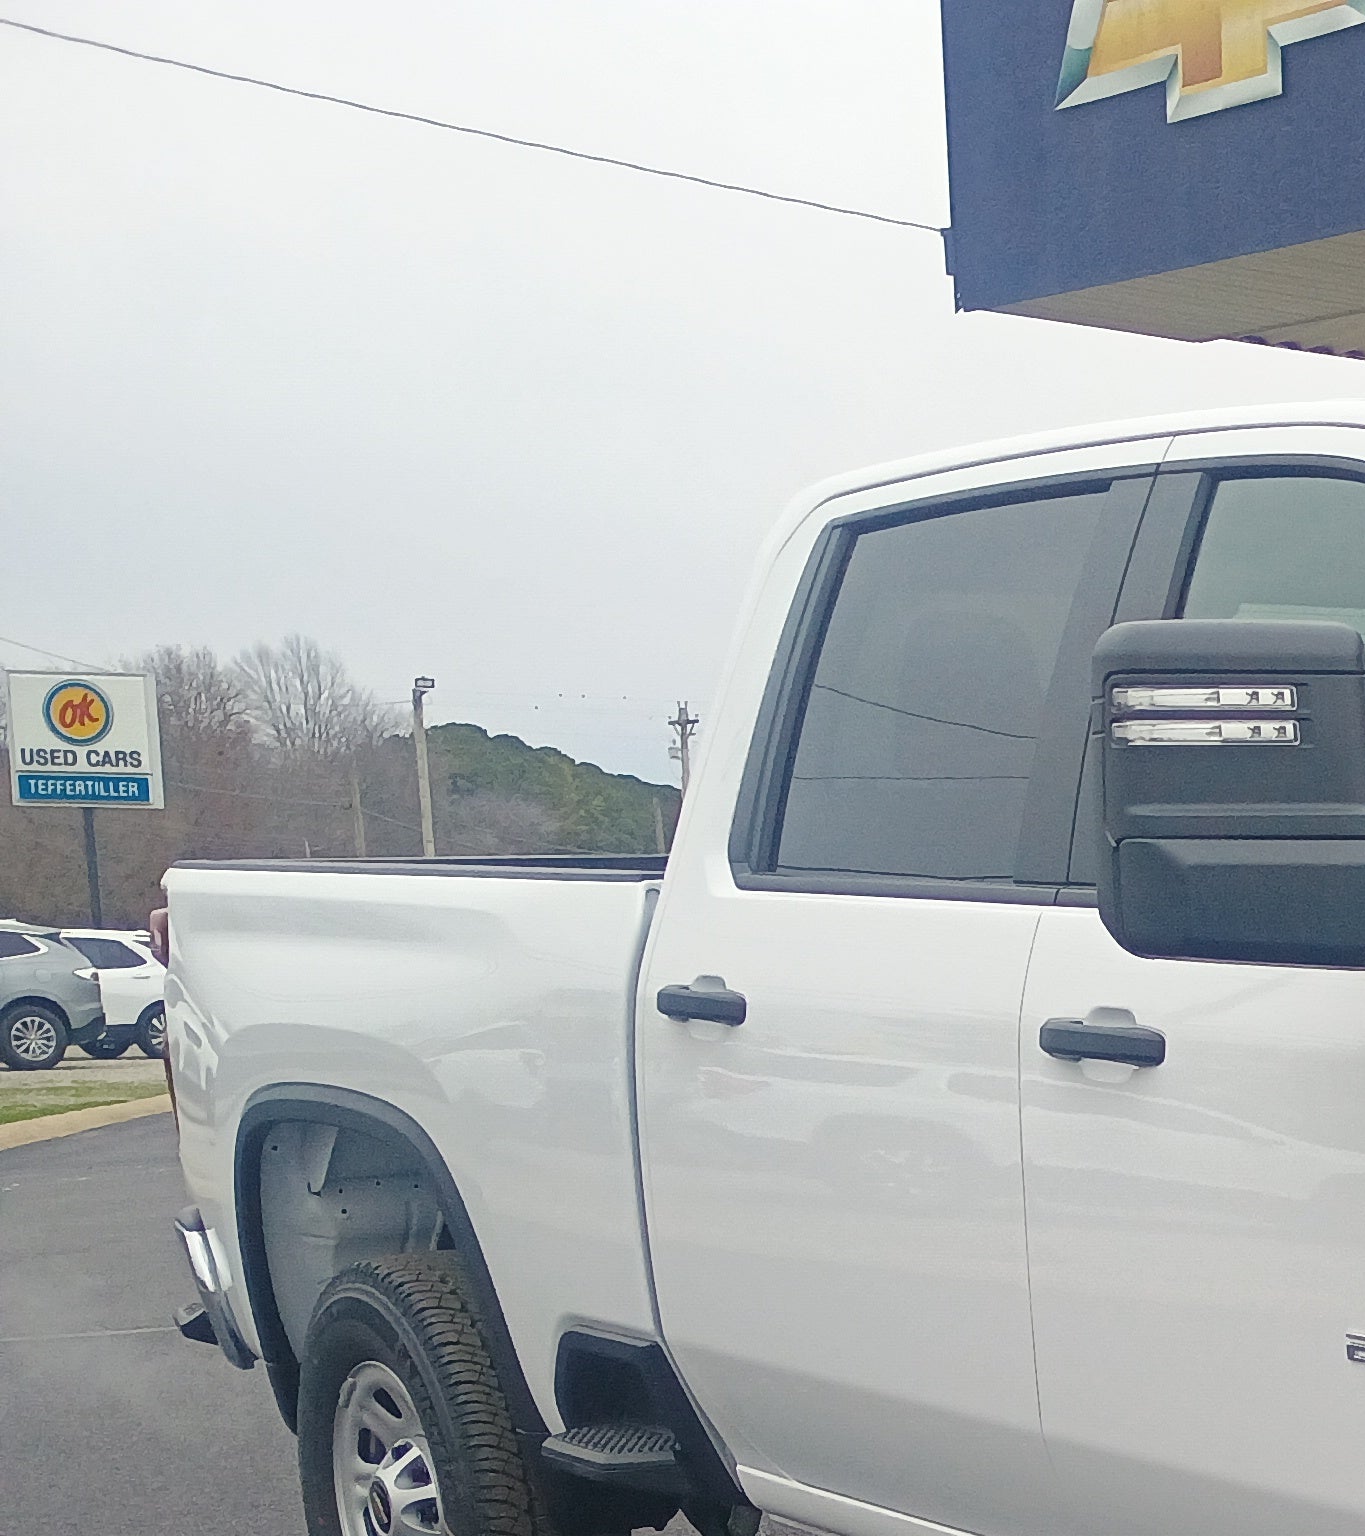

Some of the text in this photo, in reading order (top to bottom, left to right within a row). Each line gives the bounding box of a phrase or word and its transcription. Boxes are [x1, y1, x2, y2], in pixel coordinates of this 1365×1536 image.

[58, 692, 100, 728] OK
[20, 747, 143, 768] USED CARS
[28, 779, 139, 797] TEFFERTILLER
